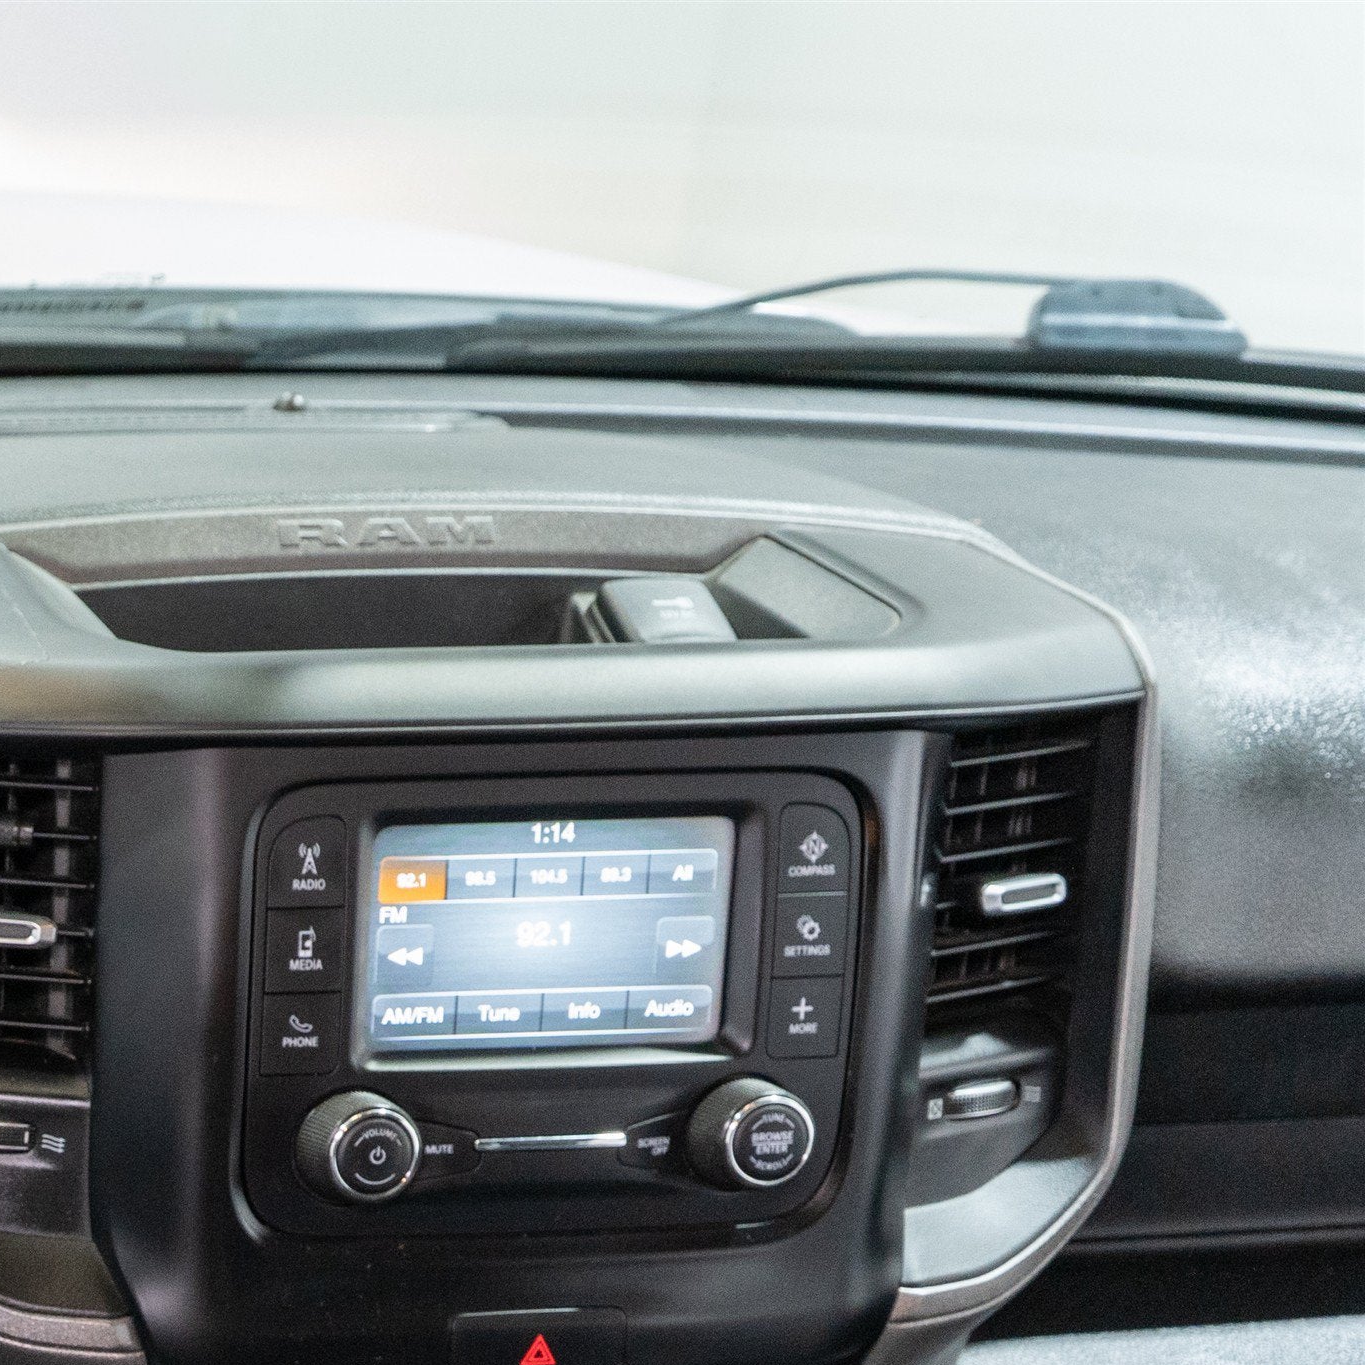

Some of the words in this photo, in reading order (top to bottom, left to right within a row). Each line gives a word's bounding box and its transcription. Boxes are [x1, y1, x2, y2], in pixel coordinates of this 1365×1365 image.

[277, 515, 495, 547] RAM
[531, 822, 576, 843] 1:14
[672, 864, 693, 881] All
[788, 864, 836, 877] COMPASS
[292, 878, 326, 891] RADIO
[379, 906, 407, 923] FM
[516, 920, 572, 947] 92.1
[784, 944, 831, 957] SETTINGS
[289, 958, 323, 971] MEDIA
[381, 1006, 444, 1025] AM/FM
[478, 1004, 520, 1022] Tune
[568, 1001, 601, 1020] Info
[644, 998, 695, 1018] Audio
[788, 1022, 818, 1034] MORE
[282, 1036, 318, 1048] PHONE
[424, 1143, 455, 1155] MUTE
